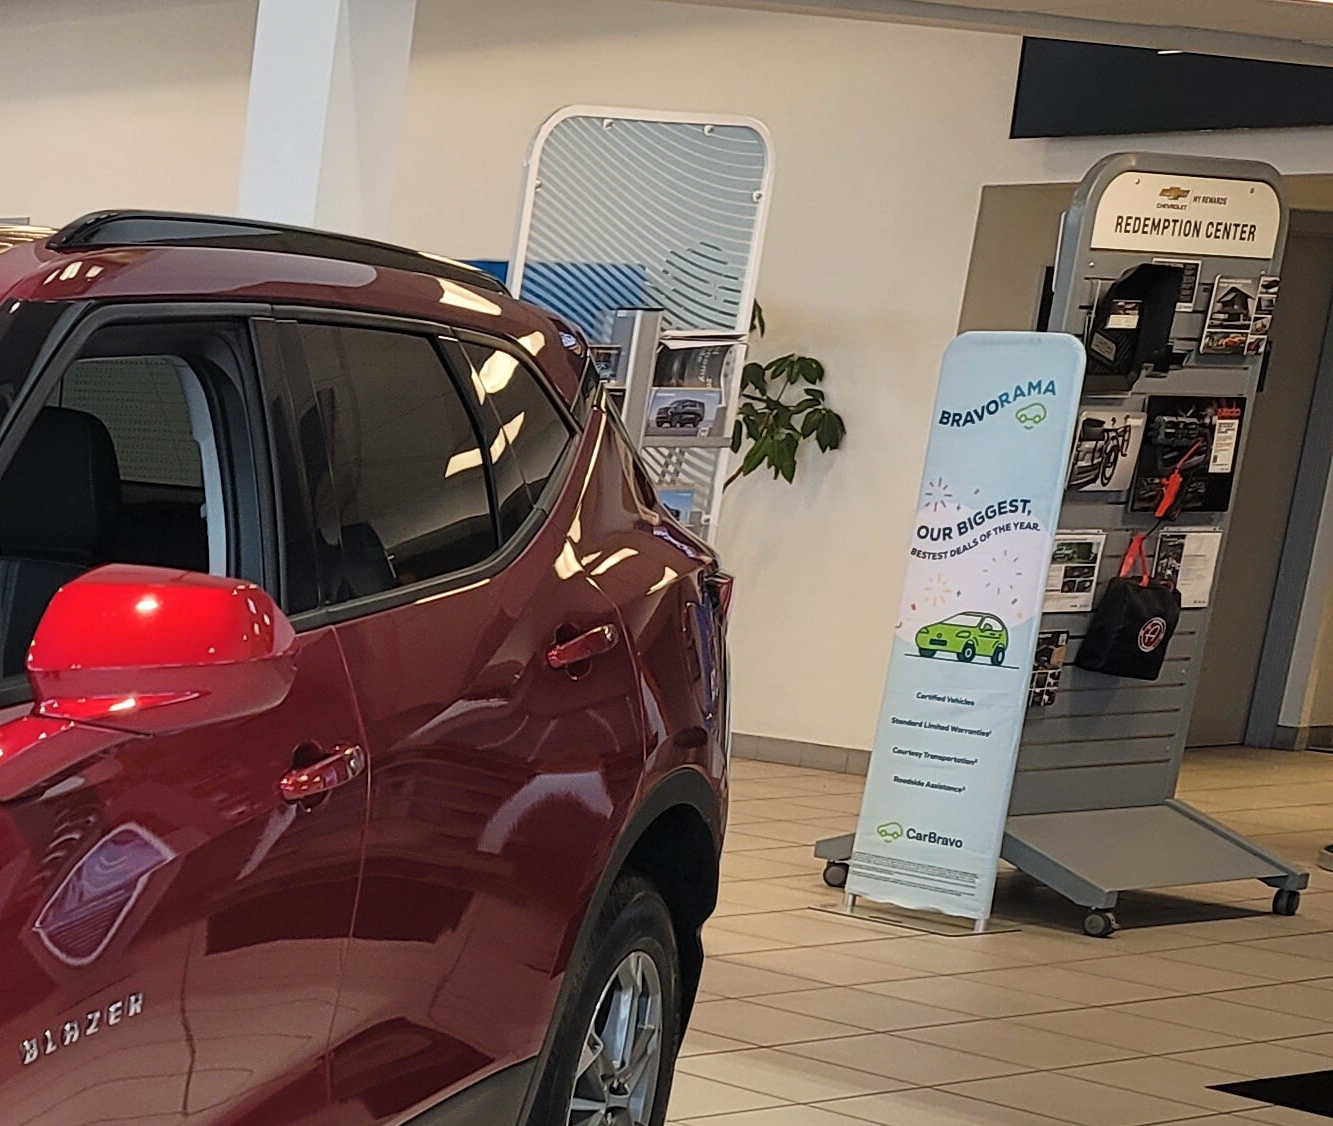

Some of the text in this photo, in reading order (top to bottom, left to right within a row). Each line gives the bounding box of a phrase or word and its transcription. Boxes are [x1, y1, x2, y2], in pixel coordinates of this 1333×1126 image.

[1114, 215, 1257, 242] REDEMPTION CENTER
[938, 379, 1057, 428] BRAVORAMA
[916, 498, 1033, 542] OUR BIGGEST,
[910, 547, 949, 561] BESTEST
[949, 538, 979, 558] DEALS
[979, 530, 993, 543] OF
[993, 522, 1012, 536] THE
[916, 692, 975, 706] Certified Vehicles
[891, 717, 923, 728] Standard
[923, 721, 950, 731] Limited
[892, 746, 923, 759] Courtesy
[893, 775, 925, 787] Roadside
[906, 828, 963, 849] CarBravo
[21, 992, 143, 1065] BLAZER
